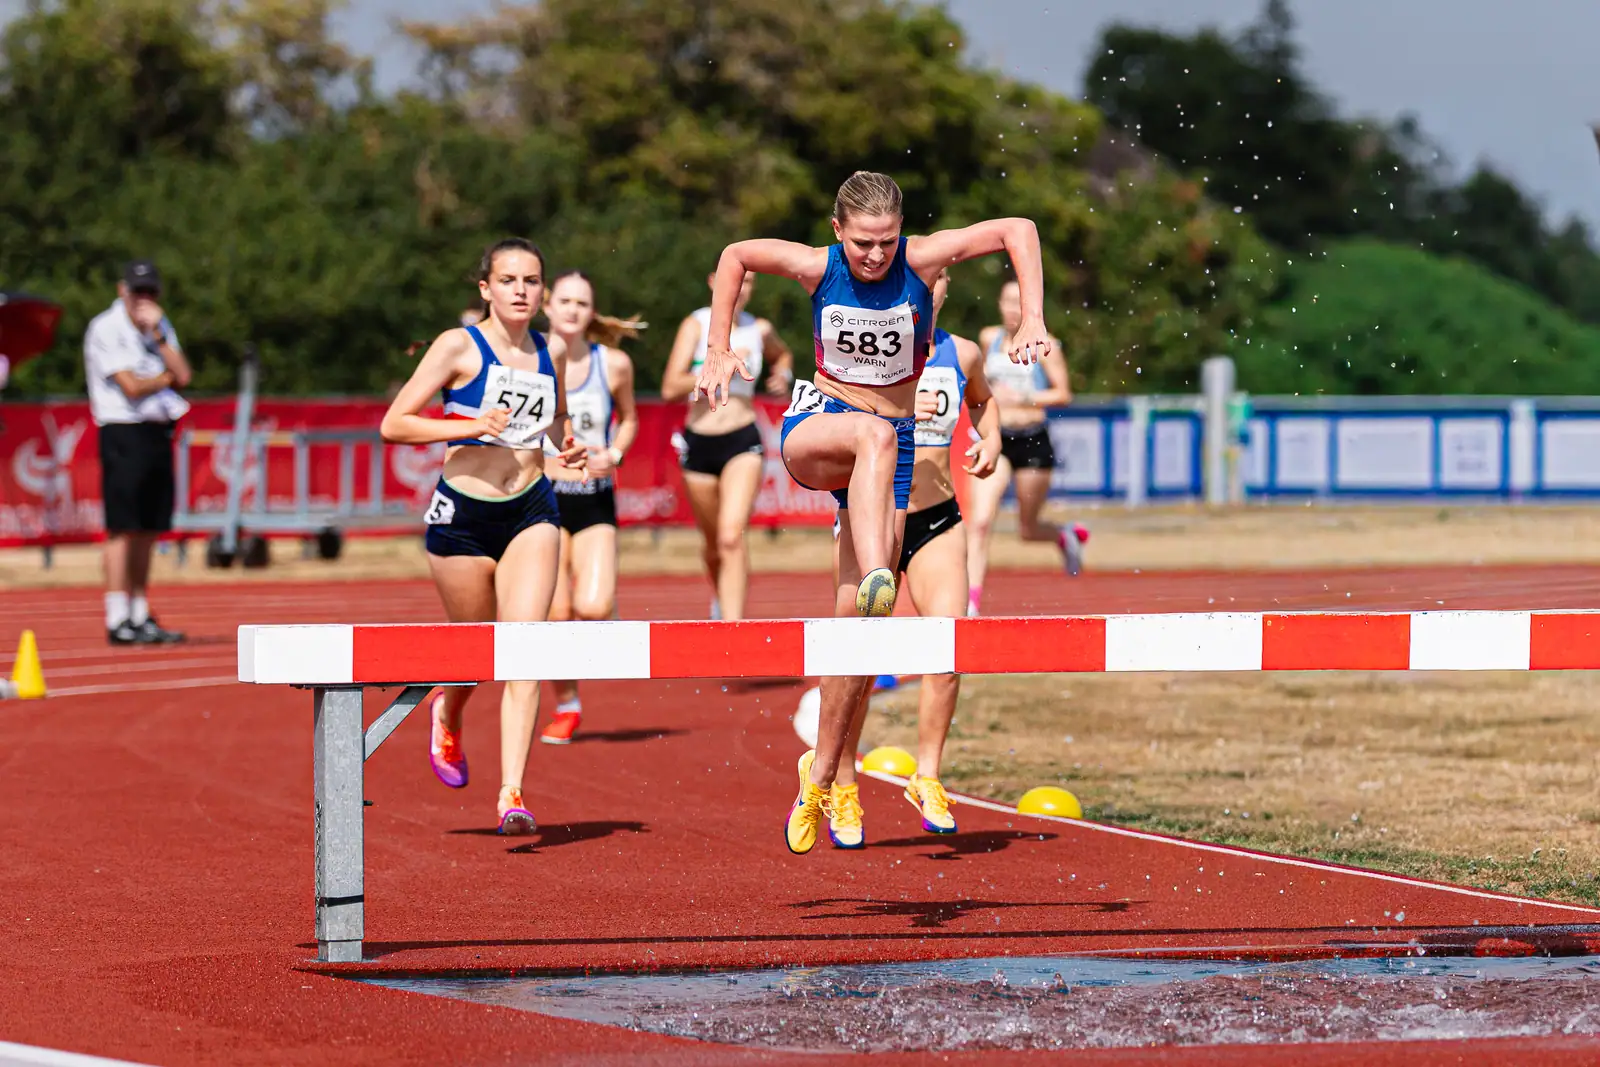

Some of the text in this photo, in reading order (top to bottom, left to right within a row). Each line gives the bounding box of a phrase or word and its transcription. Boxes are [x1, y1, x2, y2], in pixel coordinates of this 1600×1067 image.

[836, 331, 902, 357] 583
[853, 356, 887, 368] WARN
[497, 390, 545, 422] 574
[430, 499, 448, 520] 5
